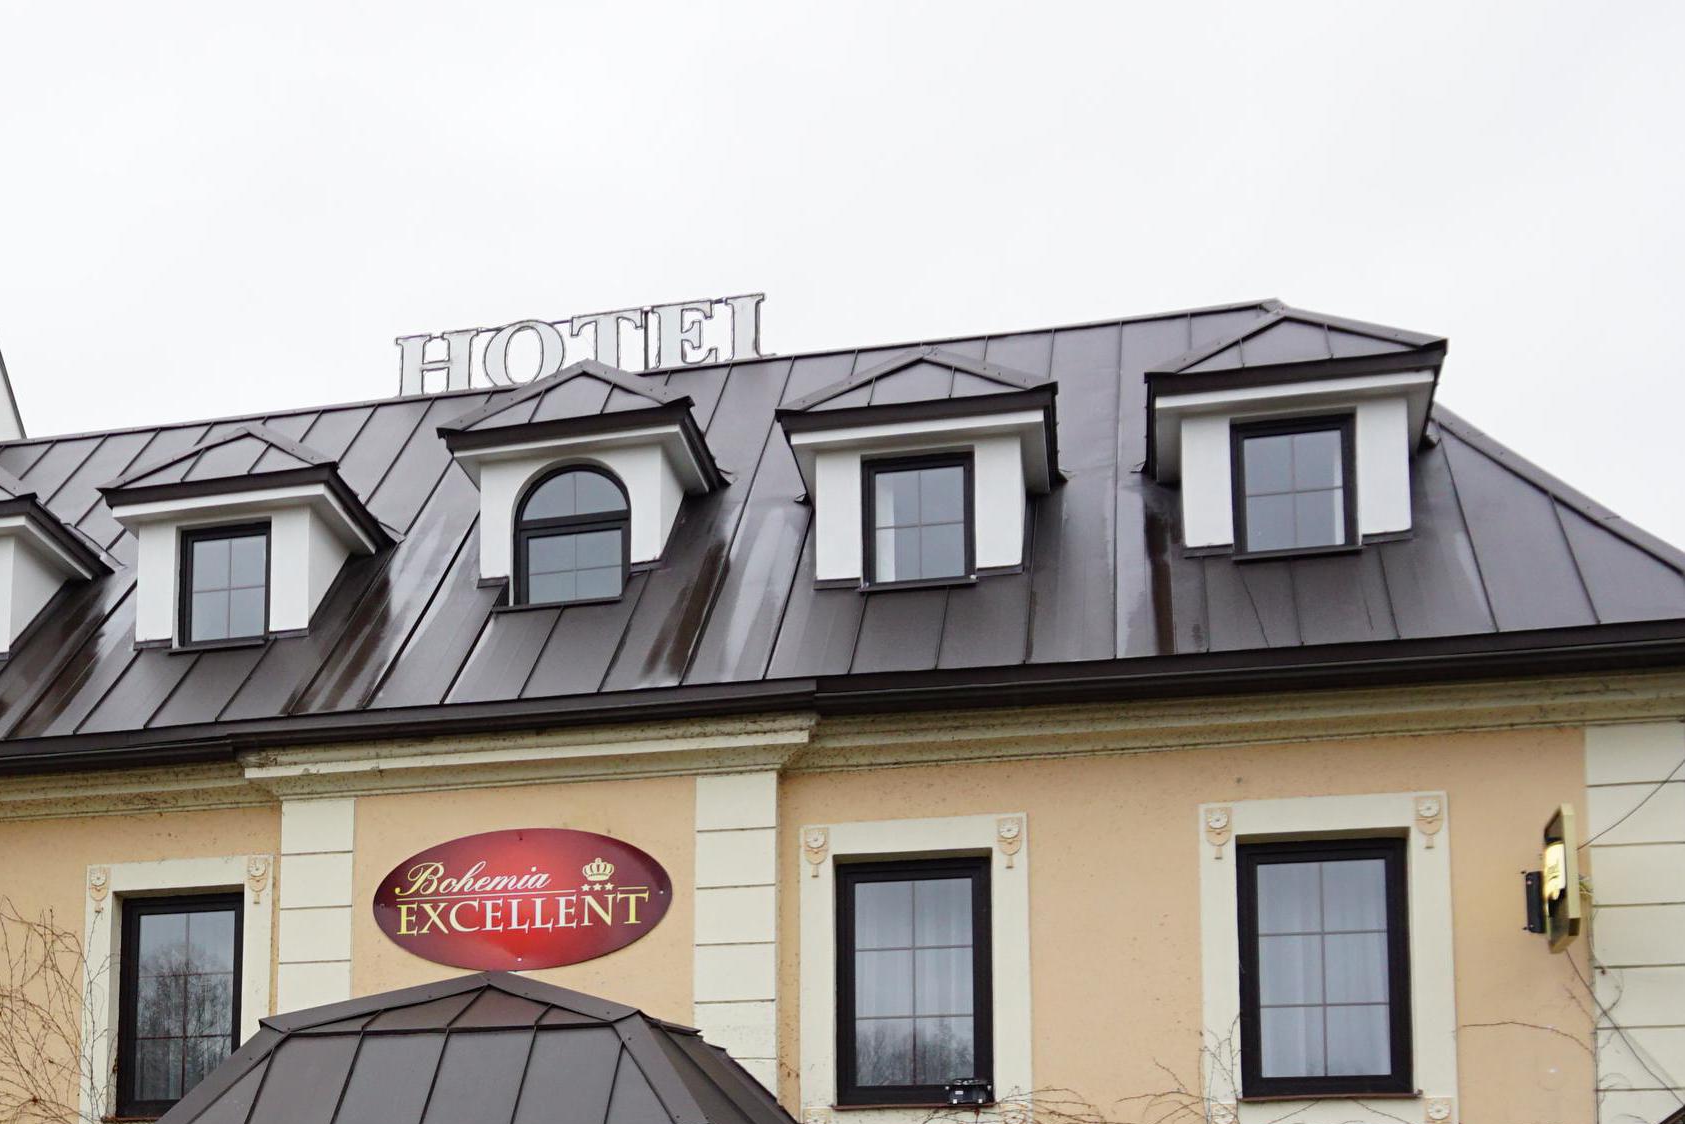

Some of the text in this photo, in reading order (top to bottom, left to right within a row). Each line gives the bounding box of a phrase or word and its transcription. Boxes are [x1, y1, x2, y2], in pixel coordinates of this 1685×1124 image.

[396, 293, 775, 398] HOTEL
[395, 861, 551, 896] Bohemia
[396, 890, 649, 936] EXCELLENT
